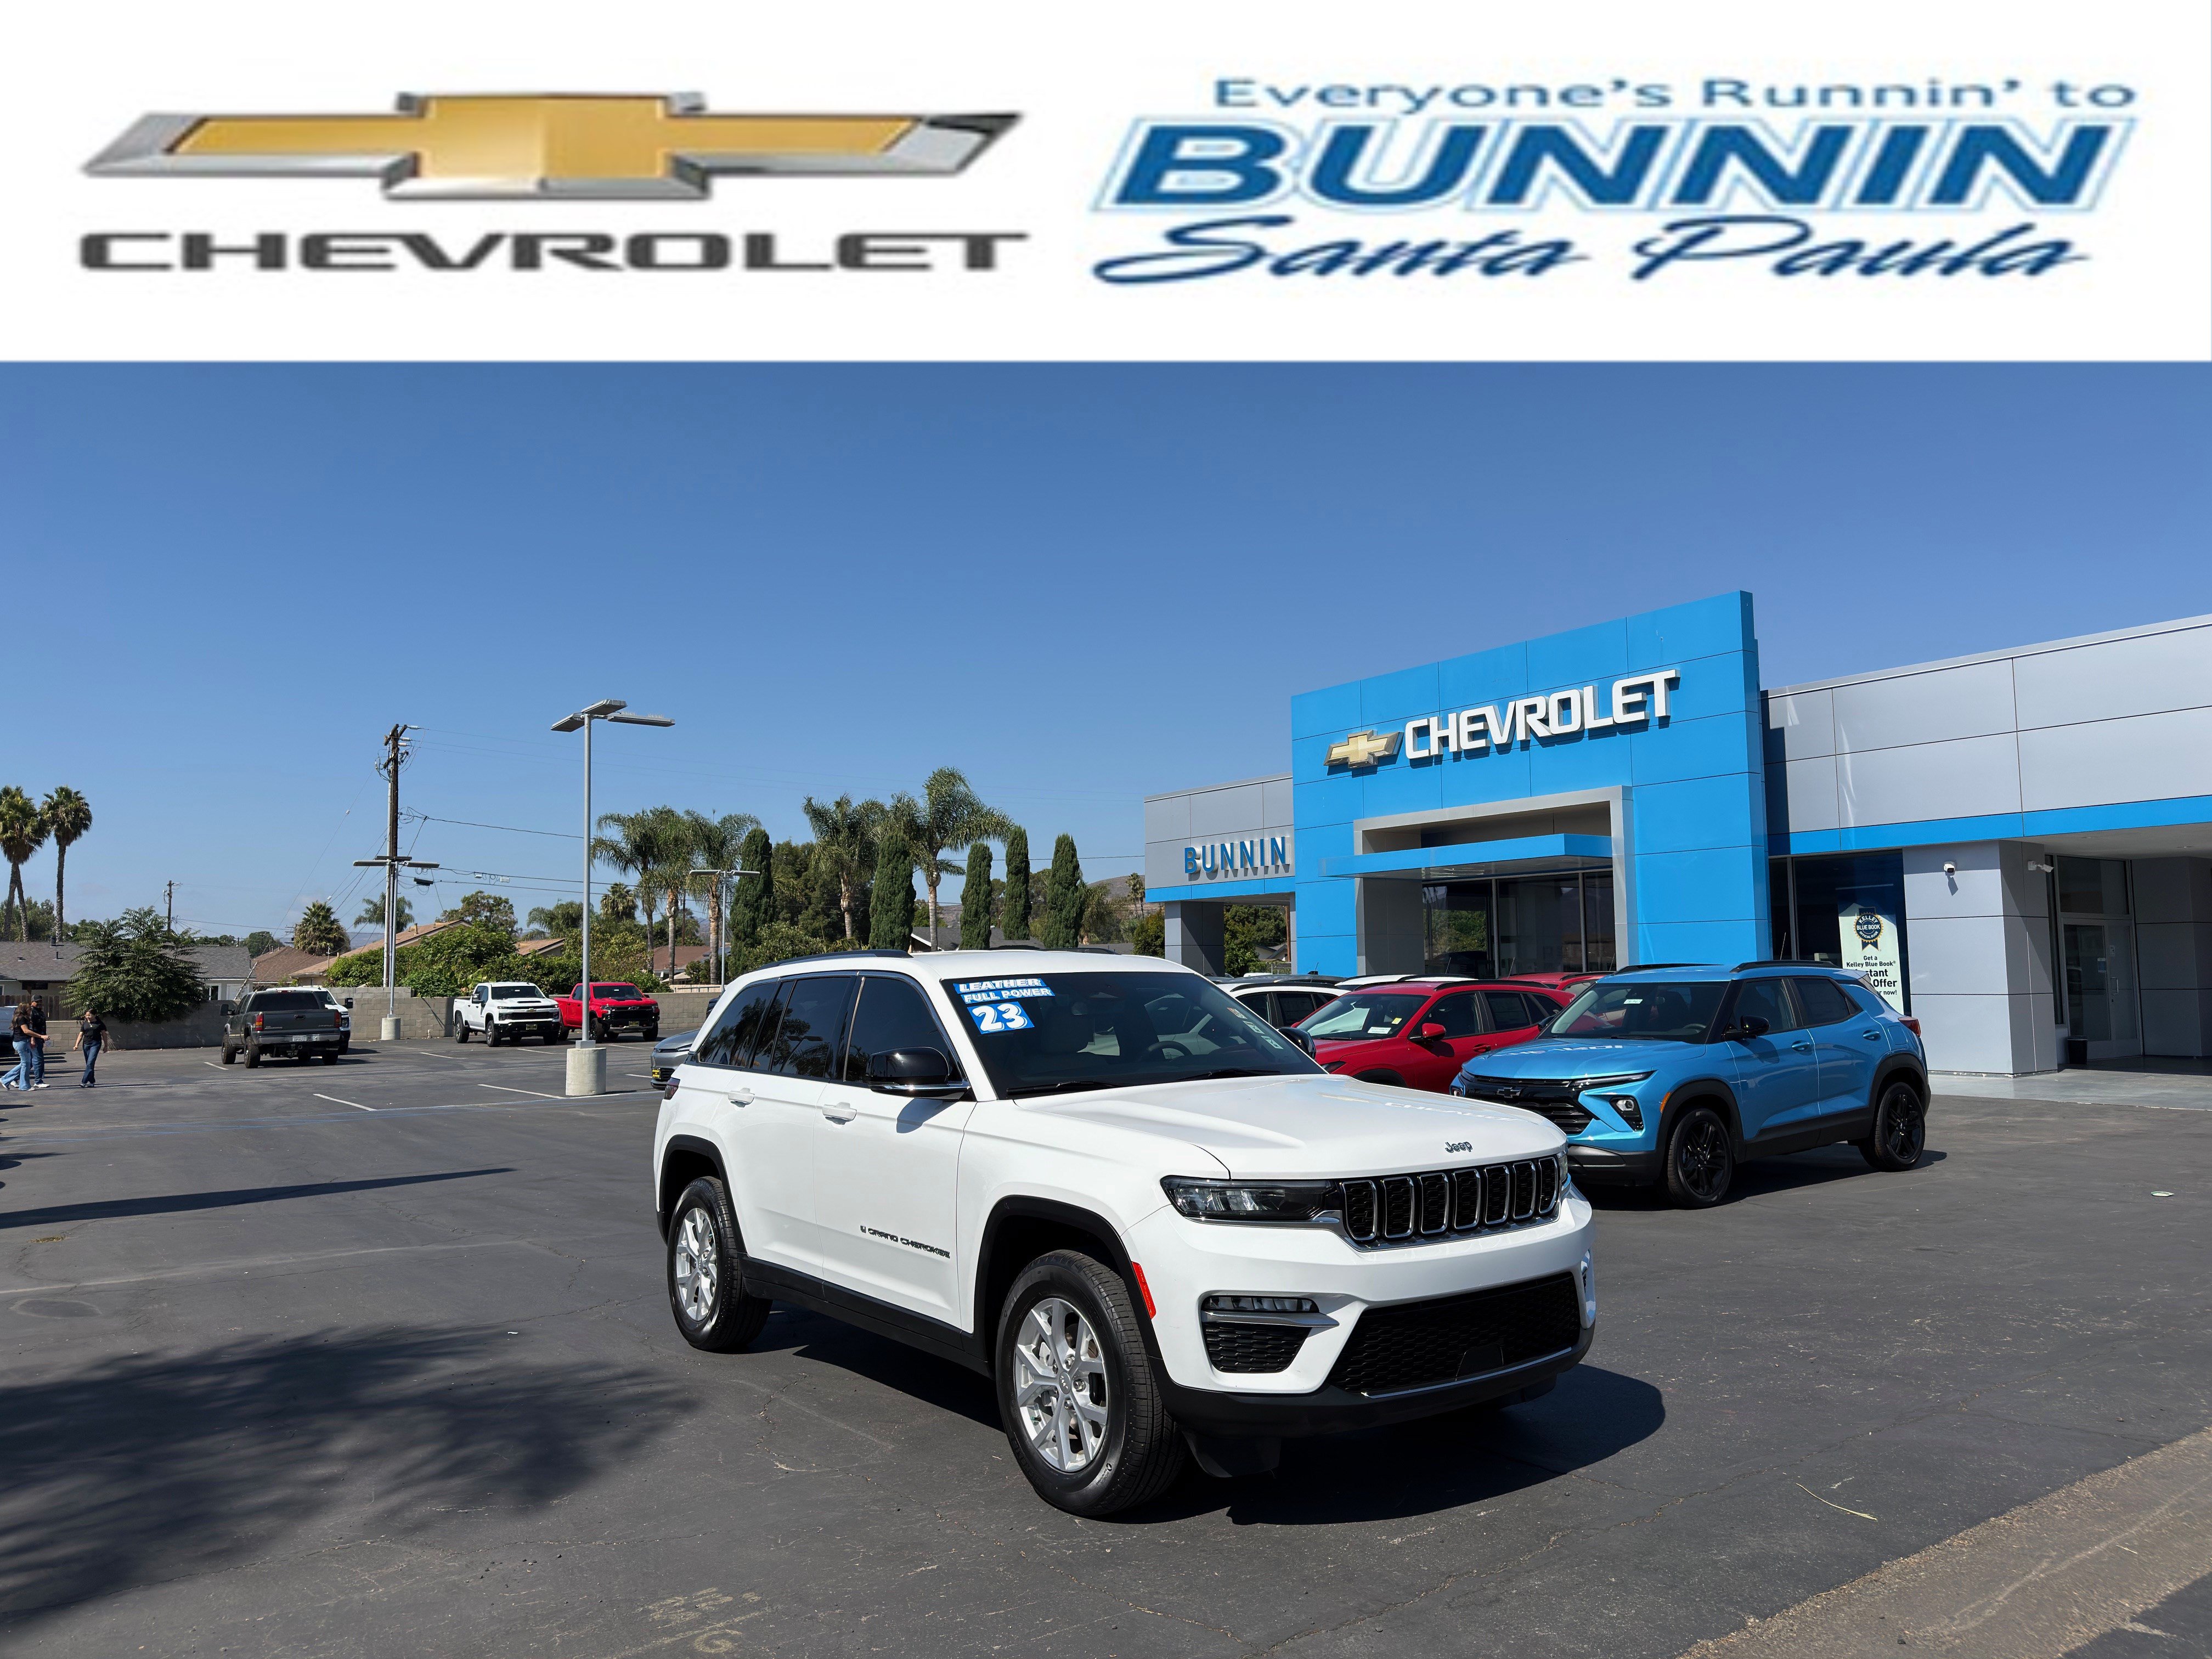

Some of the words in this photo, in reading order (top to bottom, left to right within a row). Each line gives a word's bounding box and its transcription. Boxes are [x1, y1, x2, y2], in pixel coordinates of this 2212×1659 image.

[1404, 668, 1681, 760] CHEVROLET
[1184, 836, 1290, 874] BUNNIN
[1858, 915, 1878, 923] KELLEY
[959, 978, 1042, 992] LEATHER
[1873, 979, 1898, 988] Offer
[964, 992, 1000, 1003] FULL
[1002, 988, 1052, 999] POWER
[972, 1003, 1028, 1031] 23
[1444, 1141, 1474, 1153] Jeep
[868, 1228, 899, 1243] GRAND
[900, 1237, 950, 1259] CHEROKEE
